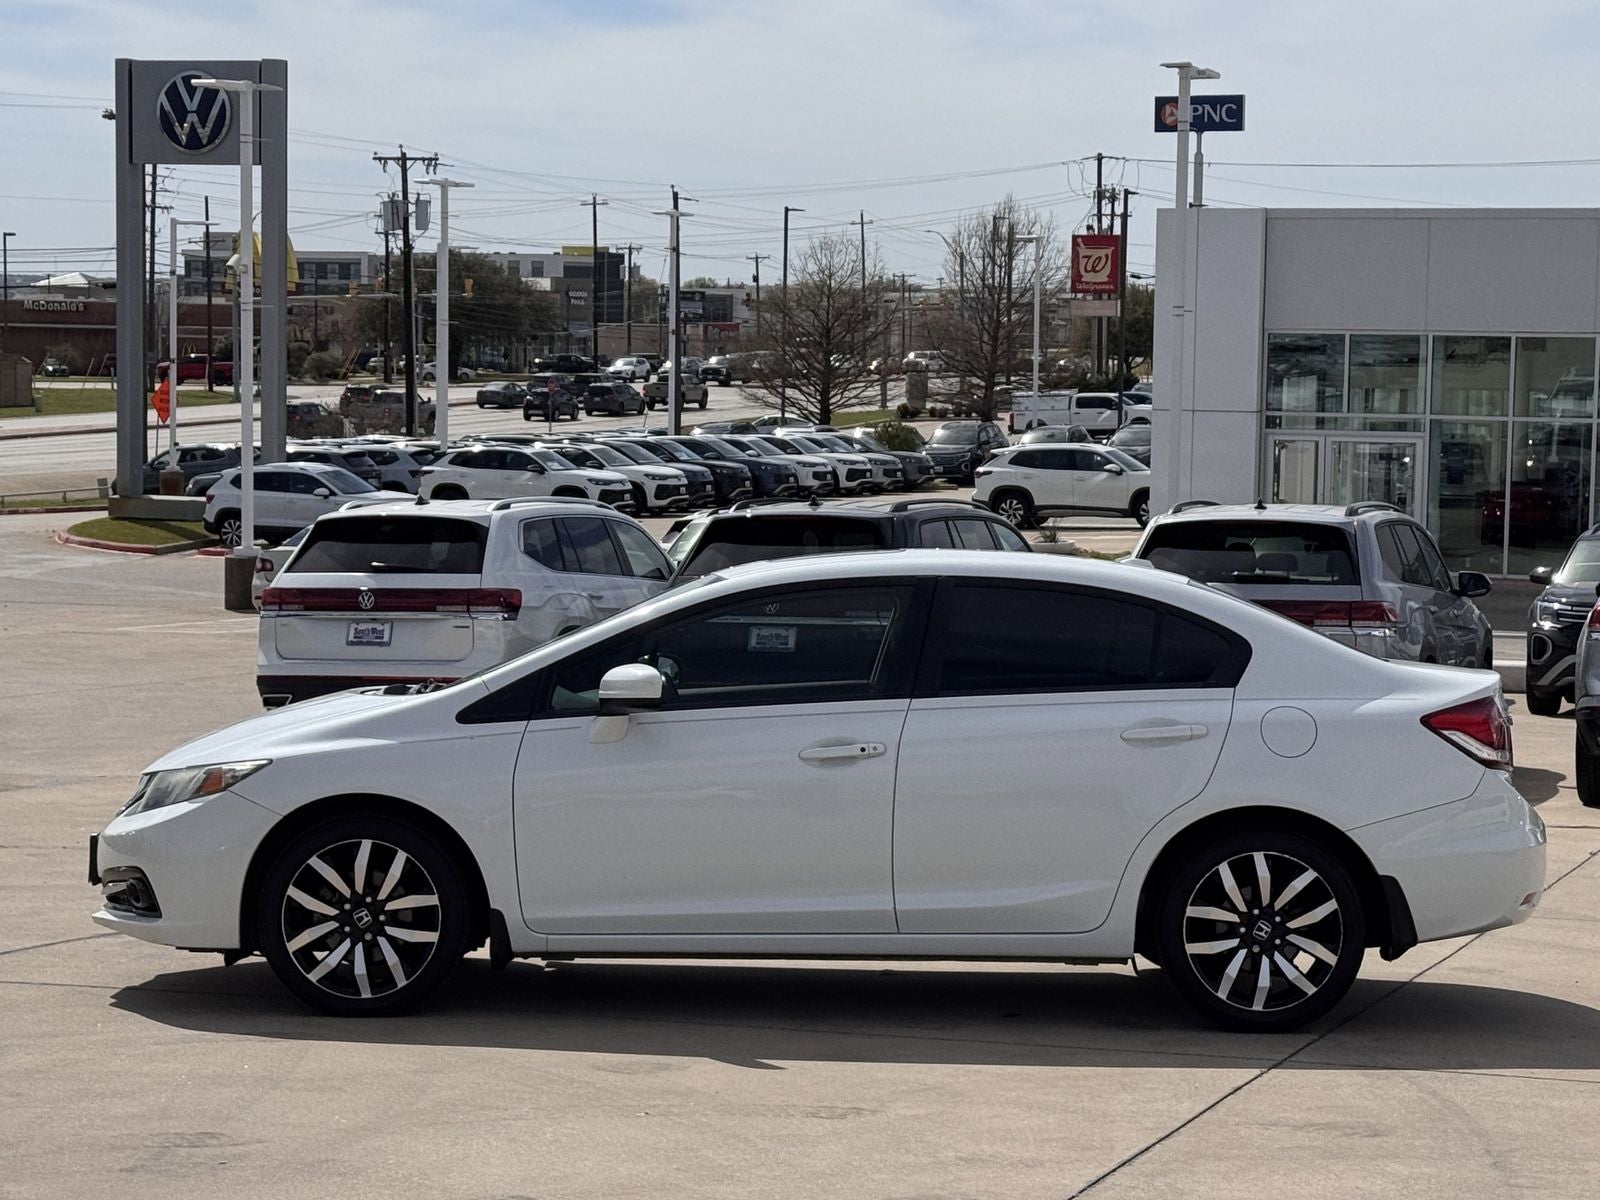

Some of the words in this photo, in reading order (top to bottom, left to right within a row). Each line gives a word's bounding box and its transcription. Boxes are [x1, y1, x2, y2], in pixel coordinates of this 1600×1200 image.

[158, 71, 230, 152] VW
[1189, 103, 1237, 123] PNC
[23, 299, 85, 311] McDonald's
